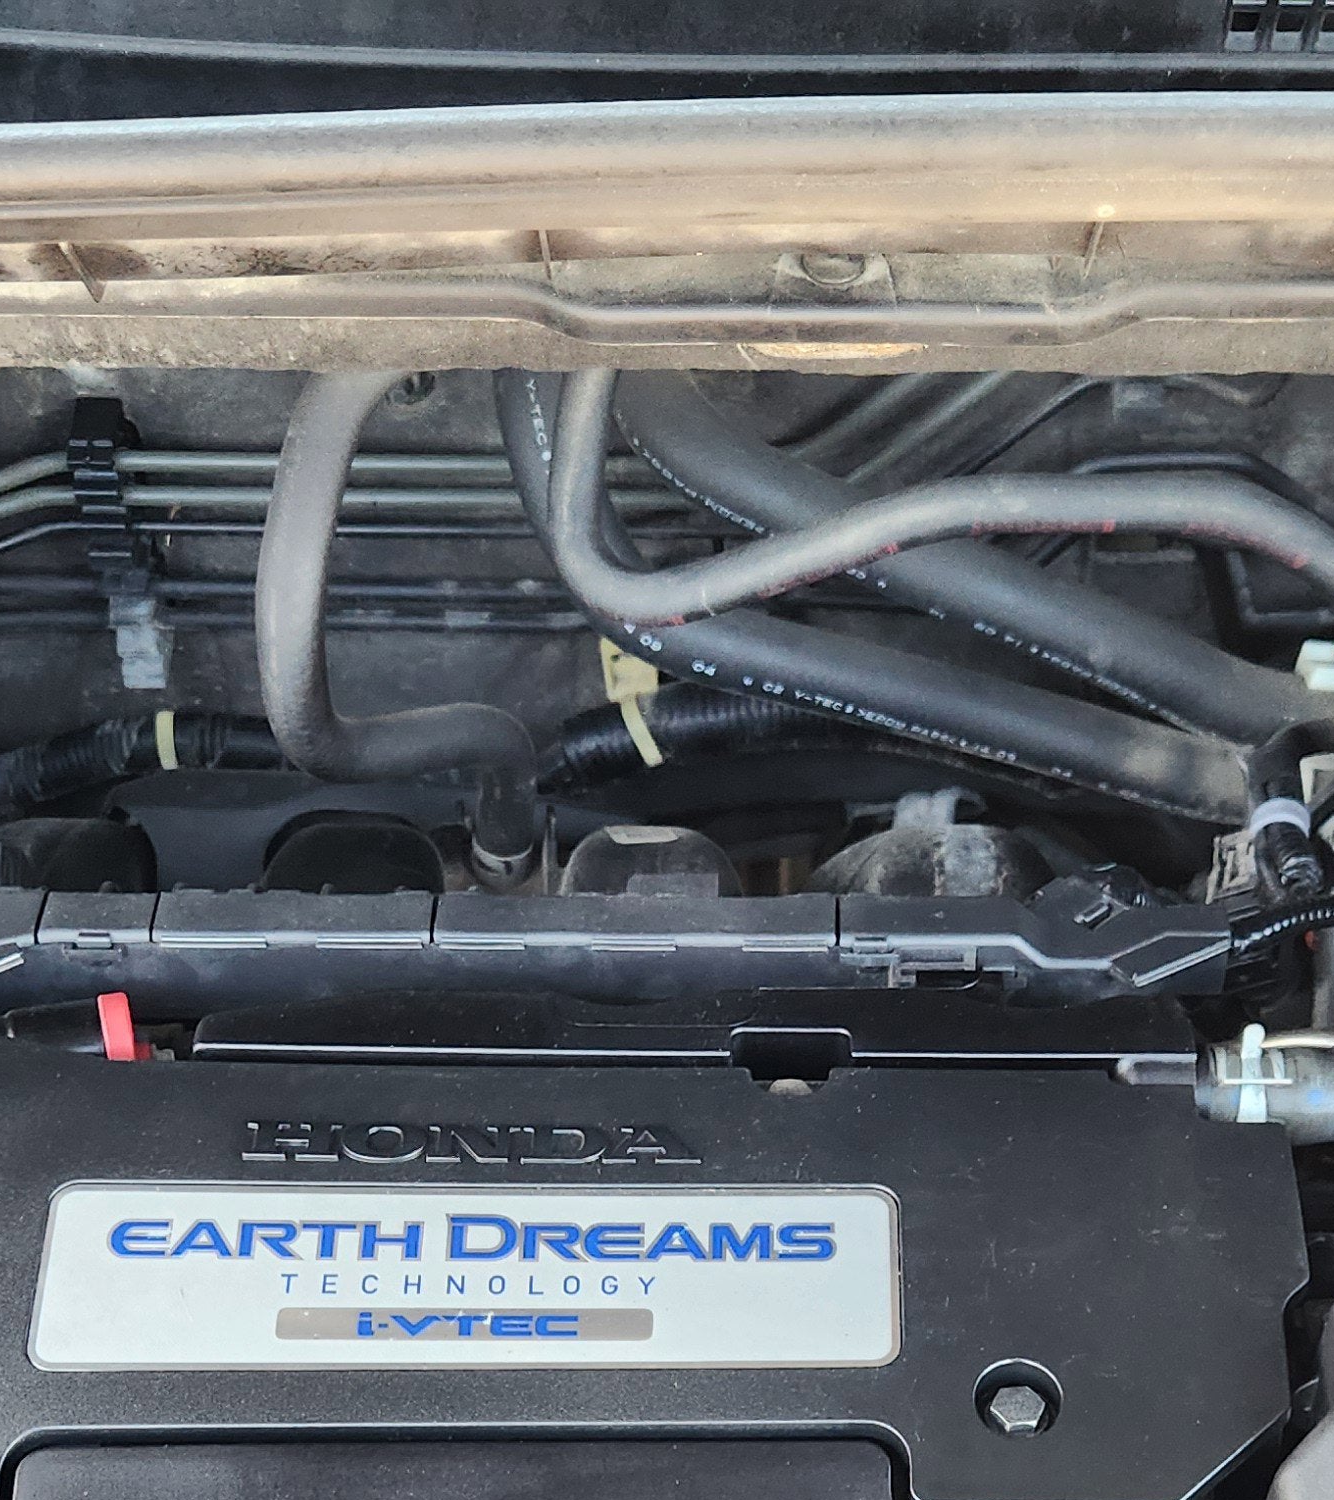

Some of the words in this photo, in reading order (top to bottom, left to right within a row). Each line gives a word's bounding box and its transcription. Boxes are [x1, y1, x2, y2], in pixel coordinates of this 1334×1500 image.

[240, 1121, 703, 1164] HONDA
[107, 1217, 424, 1263] EARTH
[446, 1212, 837, 1264] DREAMS
[280, 1272, 657, 1297] TECHNOLOGY
[356, 1310, 580, 1337] i-VTEC
